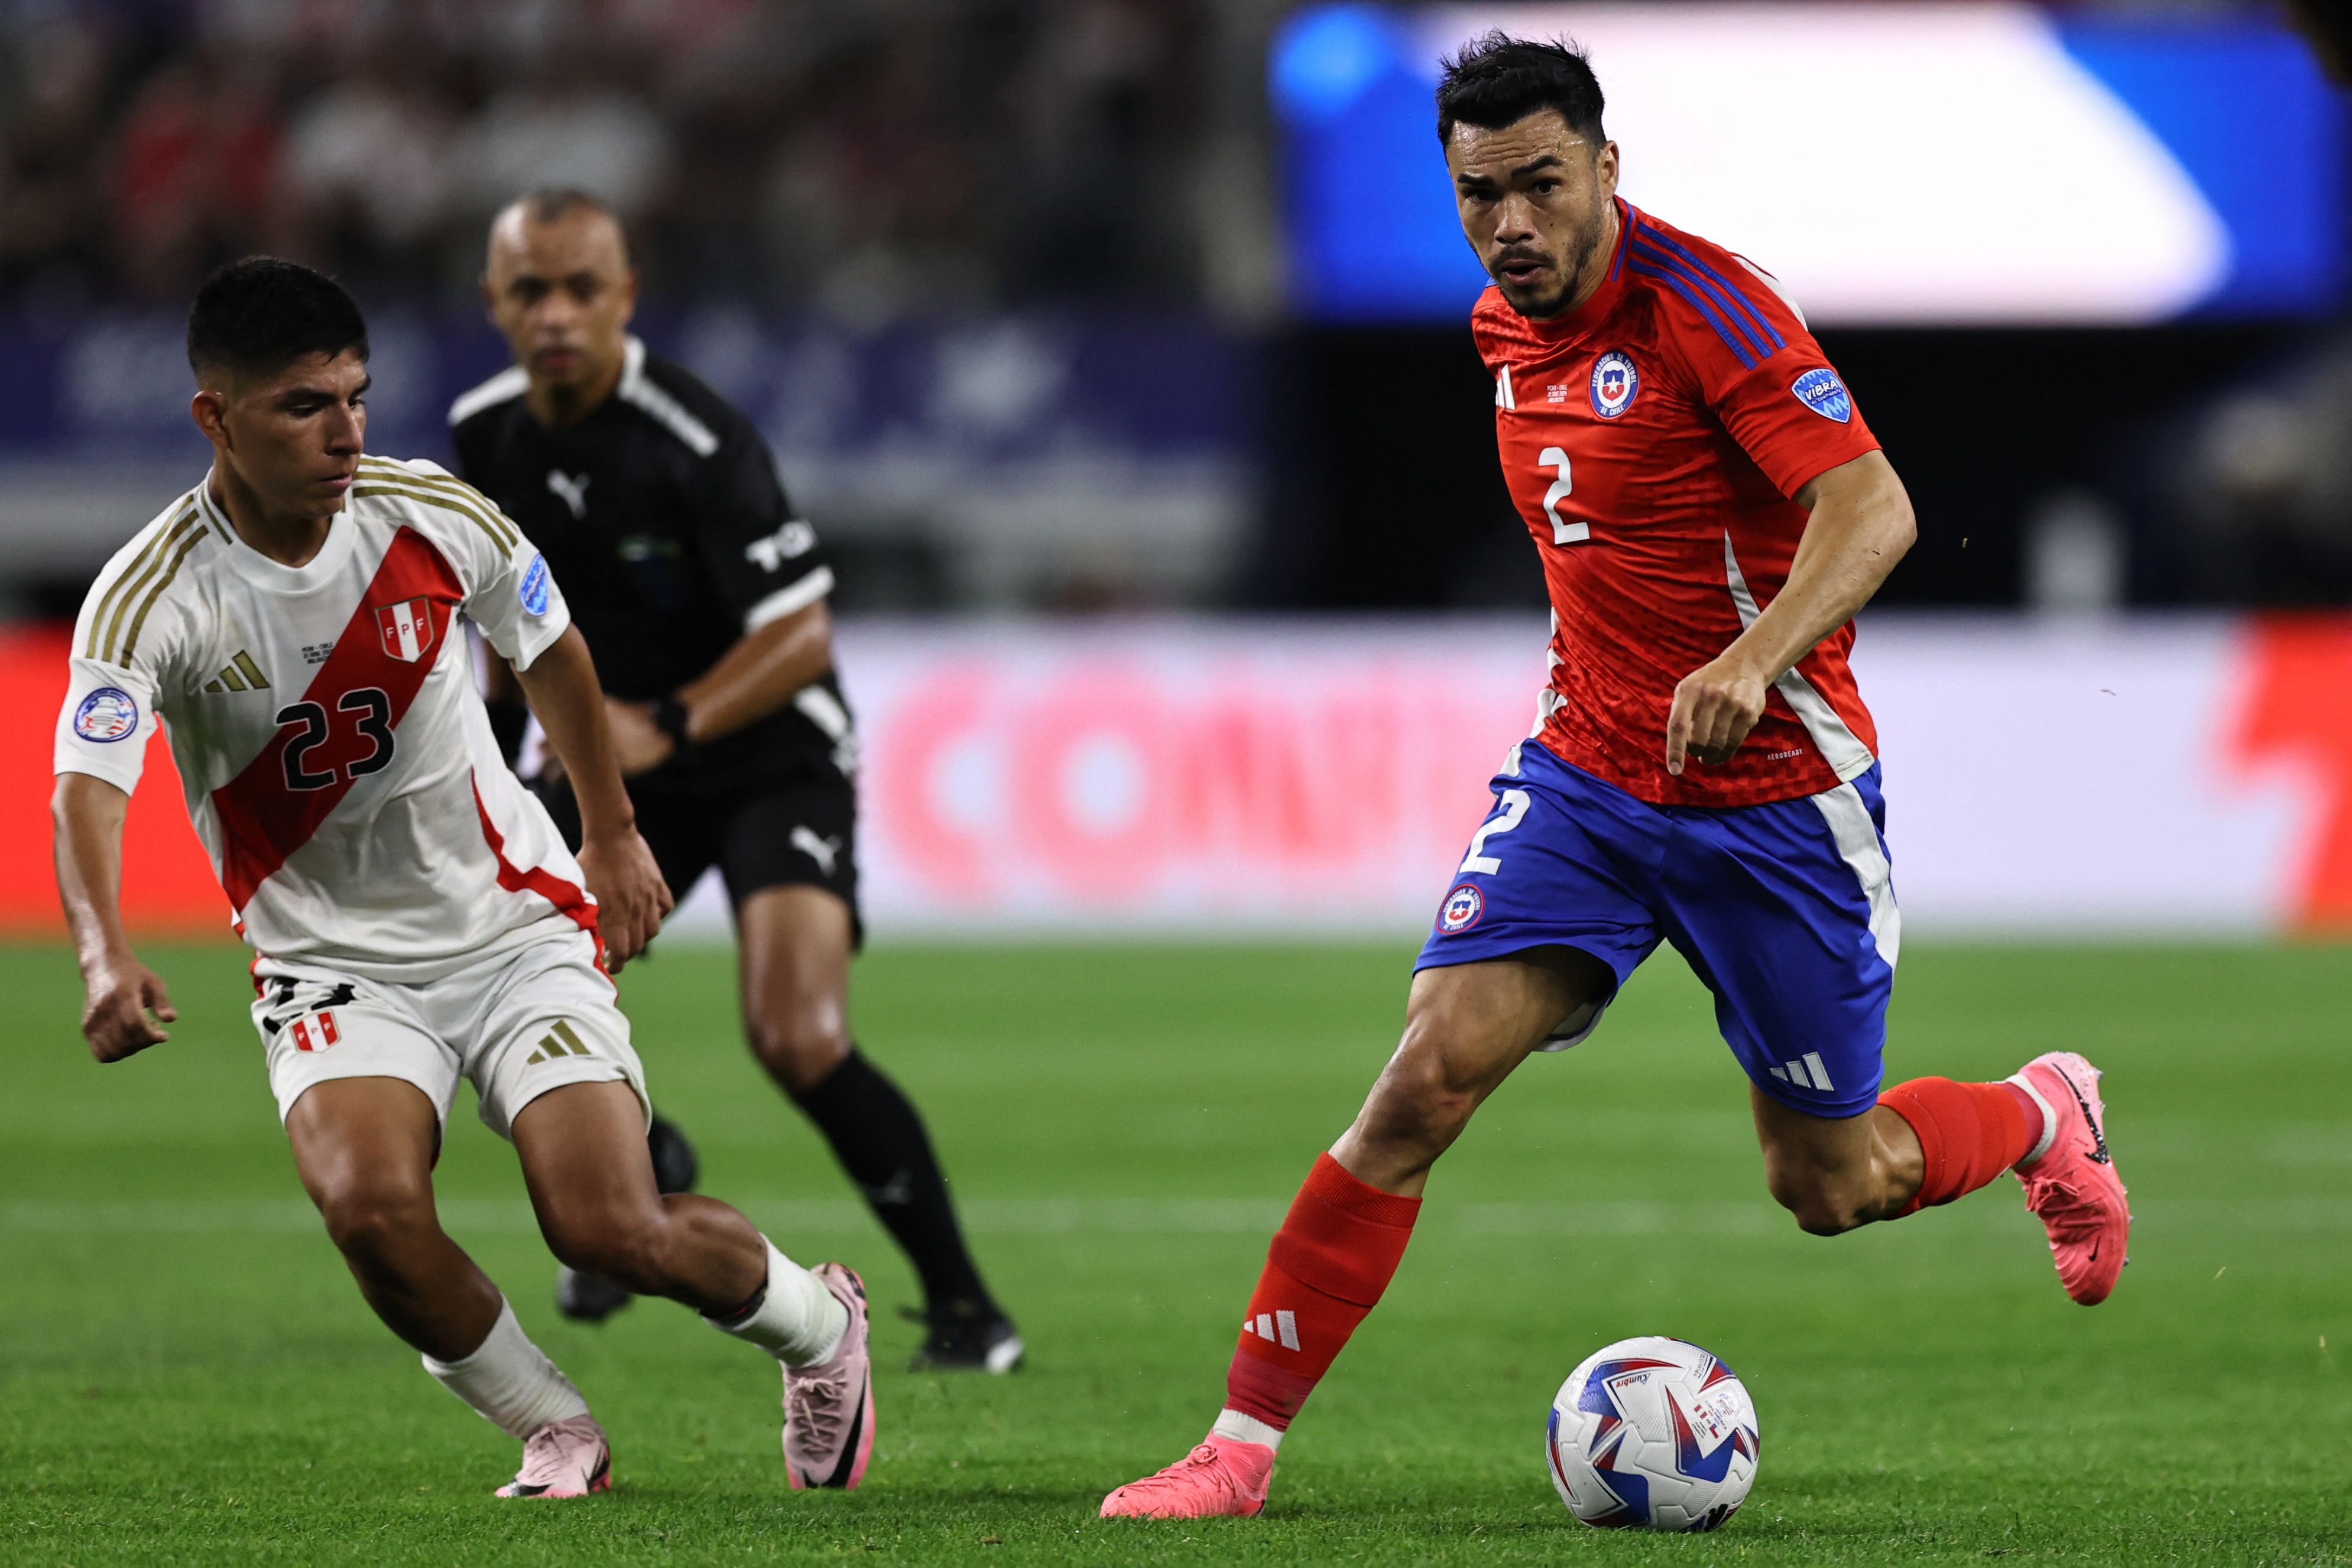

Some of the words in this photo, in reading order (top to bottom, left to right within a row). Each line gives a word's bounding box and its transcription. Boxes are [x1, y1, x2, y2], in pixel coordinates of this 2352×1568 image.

[1617, 353, 1624, 362] DE
[1624, 359, 1637, 384] FUTBOL
[1805, 379, 1838, 401] VIBRA
[1600, 407, 1608, 415] DE
[1609, 404, 1626, 416] CHILE
[1538, 446, 1590, 545] 2
[274, 686, 396, 792] 23
[1767, 748, 1803, 761] AEROREADY
[1459, 789, 1531, 876] 2
[1616, 1372, 1651, 1388] Cumbre
